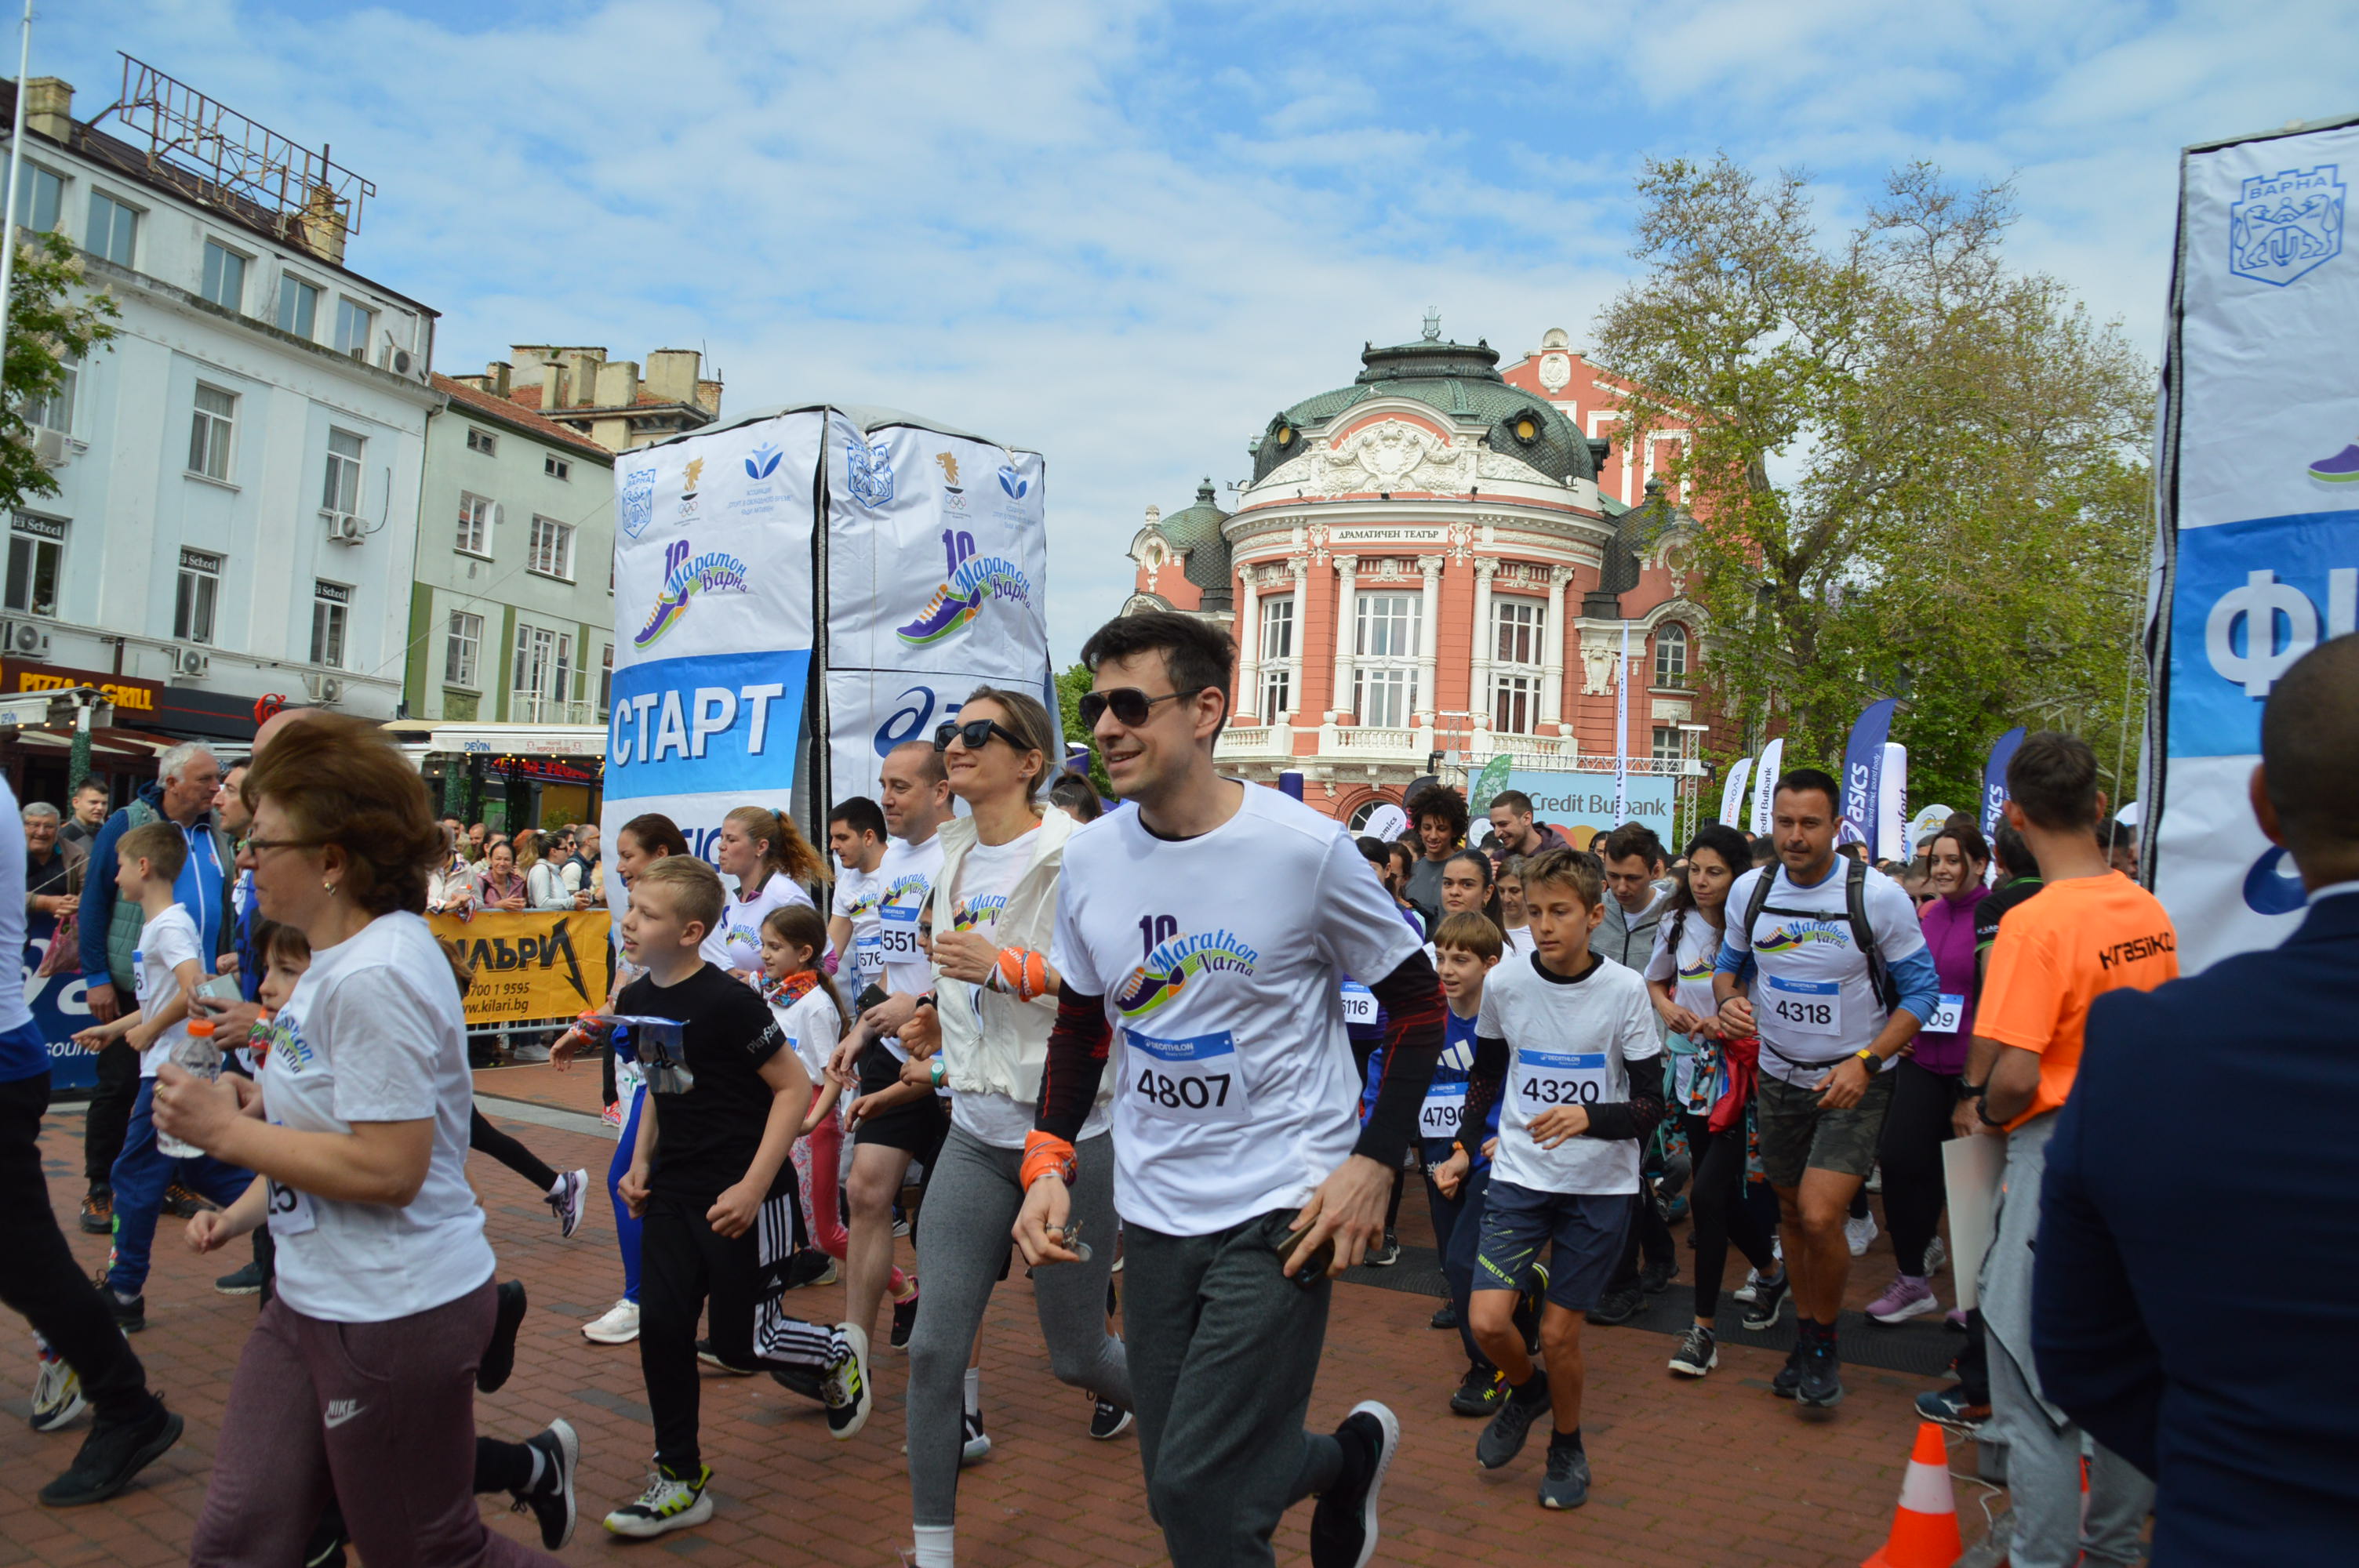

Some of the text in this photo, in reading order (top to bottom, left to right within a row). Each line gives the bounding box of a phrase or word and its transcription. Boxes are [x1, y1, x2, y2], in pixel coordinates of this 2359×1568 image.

[2249, 176, 2328, 198] ВАРНА
[13, 515, 62, 537] Hi School
[1339, 530, 1439, 539] ДРАМАТИЧЕН ТЕАТЪР
[188, 555, 216, 571] School
[664, 539, 690, 589] 10
[942, 528, 976, 581] 10
[668, 551, 747, 598] Маратон
[699, 569, 748, 592] Варна
[955, 557, 1030, 598] Маратон
[322, 586, 347, 601] School
[990, 574, 1031, 609] Варна
[20, 672, 153, 711] PIZZA GRILL
[612, 683, 786, 768] СТАРТ
[464, 741, 491, 752] DEVIN
[1761, 767, 1772, 810] Bulbank
[1847, 762, 1869, 822] asics
[1532, 793, 1667, 816] Credit Bubank
[892, 872, 930, 891] Marathon
[1139, 914, 1178, 962] 10
[1787, 920, 1850, 943] Marathon
[1150, 928, 1259, 977] Marathon
[1197, 950, 1254, 978] Varna
[495, 982, 500, 995] 1
[504, 982, 529, 995] 9595
[1776, 1000, 1832, 1025] 4318
[1150, 1040, 1194, 1051] DECATHLON
[1137, 1068, 1231, 1109] 4807
[1522, 1077, 1600, 1105] 4320
[328, 1398, 357, 1417] NIKE
